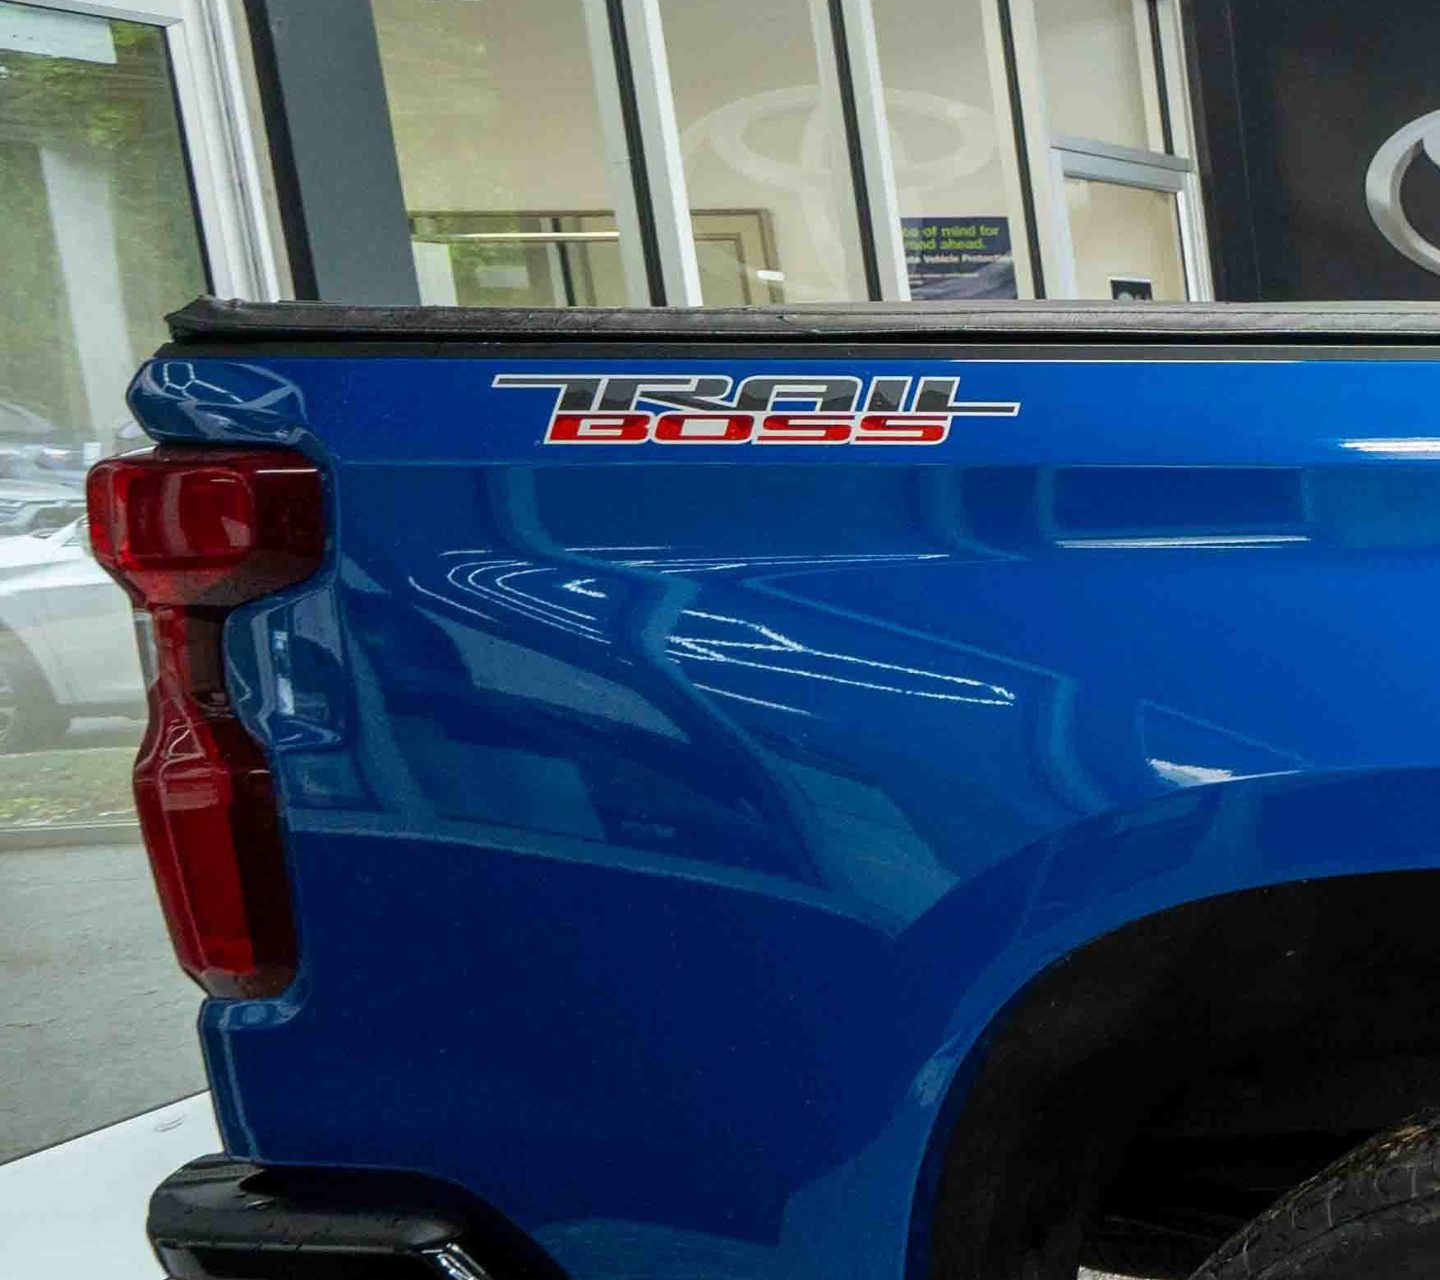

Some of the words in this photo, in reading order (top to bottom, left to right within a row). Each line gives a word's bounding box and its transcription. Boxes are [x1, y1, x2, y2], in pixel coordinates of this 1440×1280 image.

[923, 225, 938, 237] of
[941, 225, 976, 237] mind
[979, 225, 1000, 237] for
[492, 374, 1020, 417] TRAIL
[543, 411, 952, 445] BOSS
